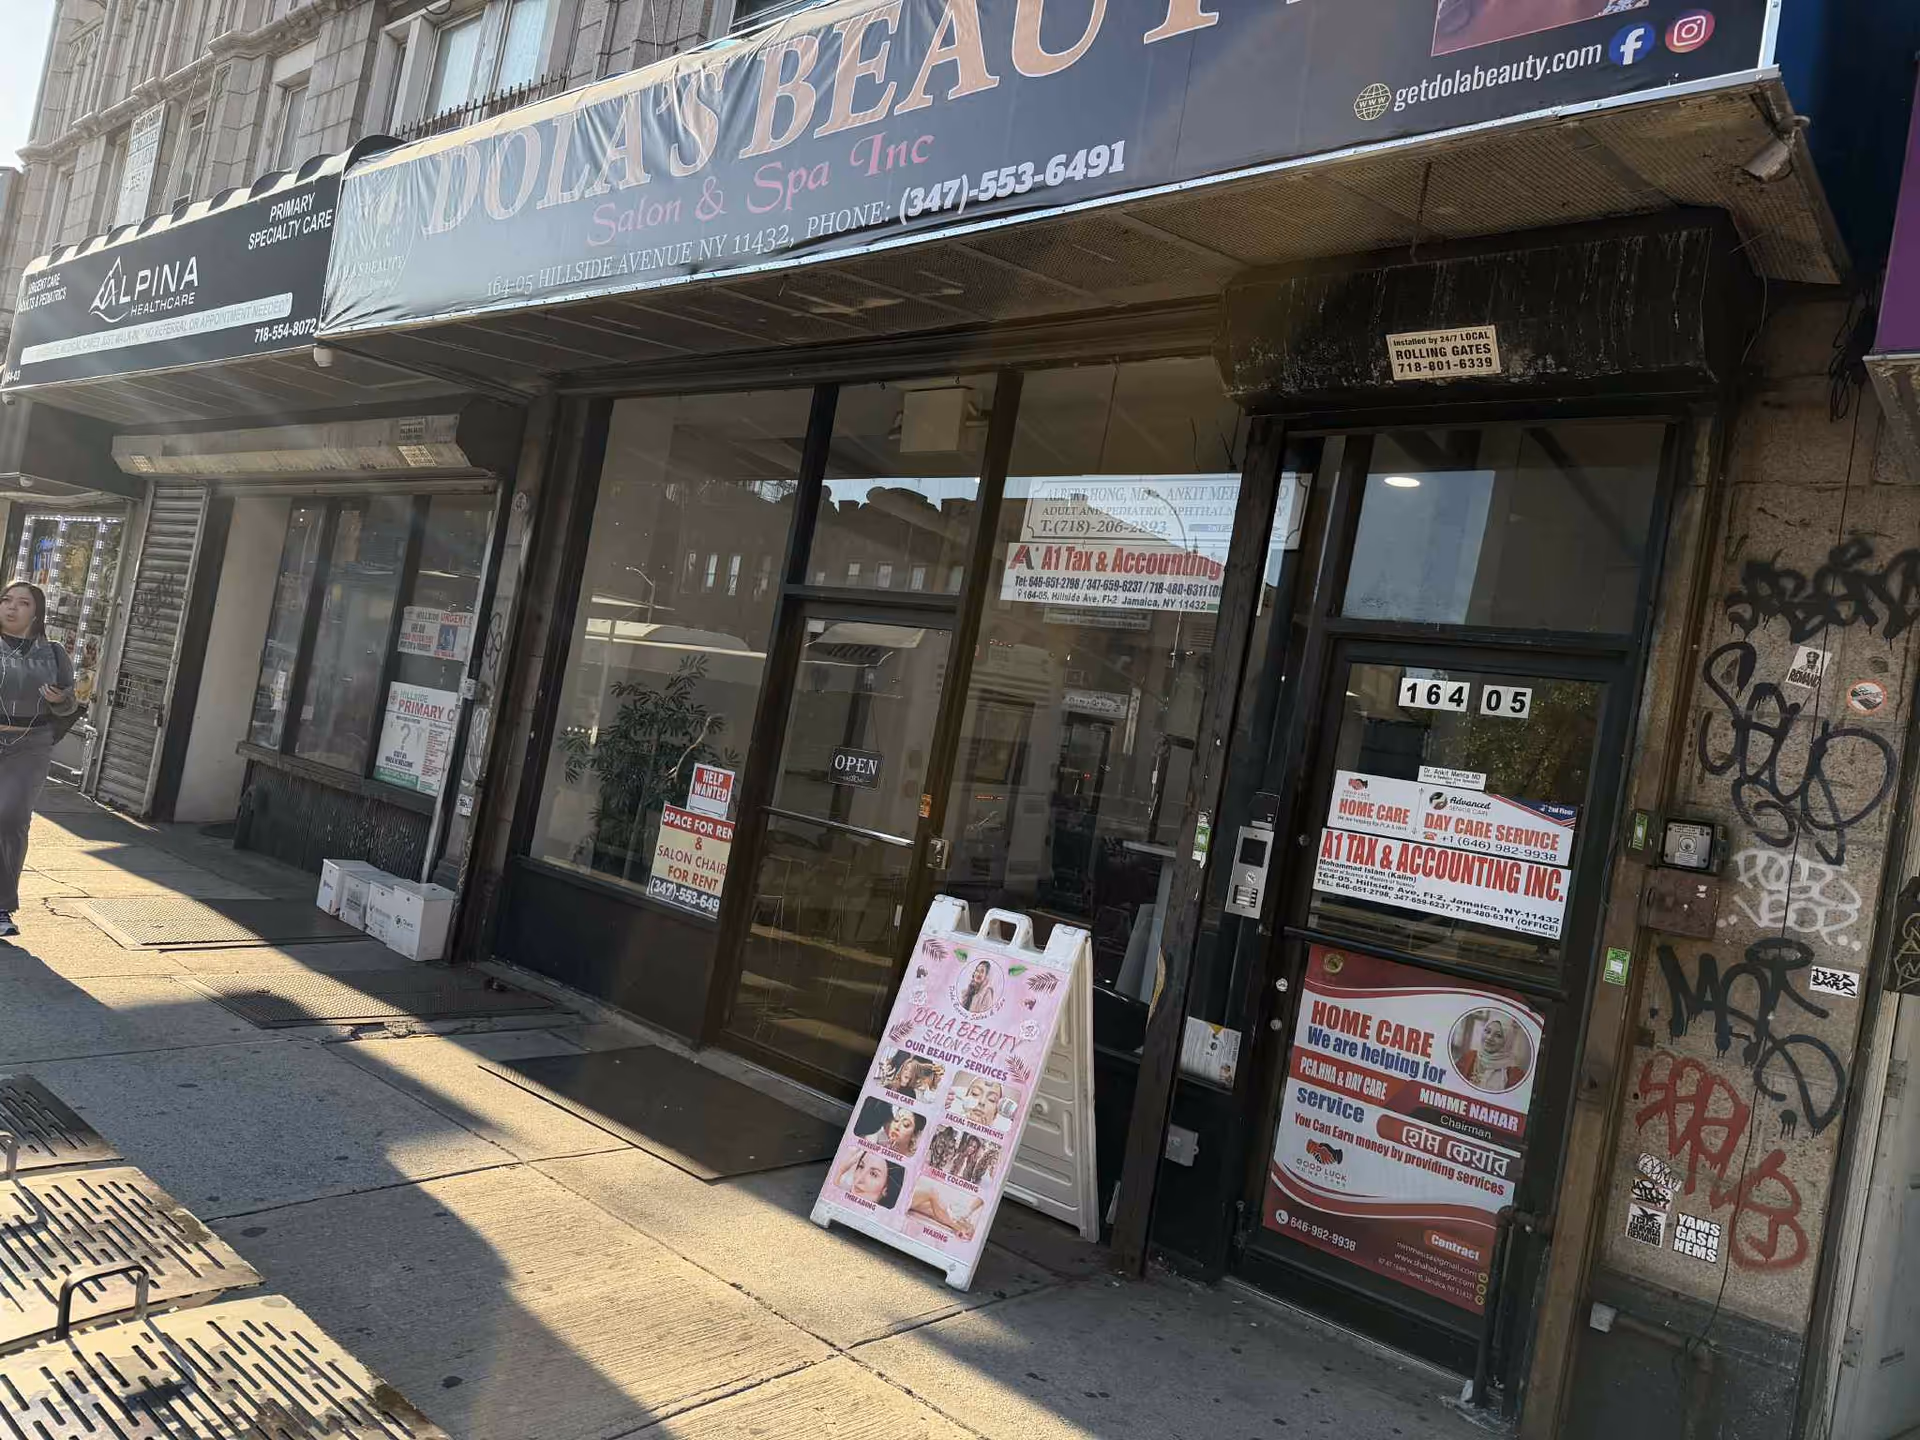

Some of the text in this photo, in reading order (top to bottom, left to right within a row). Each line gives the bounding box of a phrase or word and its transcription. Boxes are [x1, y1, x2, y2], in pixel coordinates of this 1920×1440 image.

[1393, 44, 1602, 111] getdolabeauty.com
[422, 0, 1305, 236] DOLA'S BEAU
[586, 133, 935, 247] Salon & Spa Inc
[270, 192, 315, 220] PRIMARY
[487, 140, 1126, 297] 164-05 HILLSIDE AVENUE NY 11432, PHONE: (347)-553-6491
[249, 209, 333, 250] SPECIALTY CARE
[92, 256, 200, 308] ALPINA
[130, 292, 196, 316] HEALTHCARE
[254, 318, 316, 343] 718-554-8072
[1393, 331, 1490, 346] Installed by 24/7 LOCAL
[1396, 343, 1491, 360] ROLLING GATES
[1398, 357, 1493, 373] 718-801-6339
[1042, 507, 1075, 516] ADULT
[1041, 546, 1062, 570] A1
[1065, 546, 1094, 571] Tax
[1095, 551, 1108, 572] &
[1111, 547, 1223, 581] Accounting
[1052, 592, 1081, 602] Hillside
[1162, 598, 1176, 608] NY
[1180, 599, 1207, 610] 11432
[398, 699, 444, 720] PRIMARY
[1406, 682, 1528, 713] 164 05
[703, 769, 723, 785] HELP
[834, 754, 878, 775] OPEN
[694, 782, 727, 801] WANTED
[1449, 796, 1491, 810] Advanced
[664, 810, 734, 839] SPACE FOR REN
[1338, 798, 1411, 825] HOME CARE
[694, 837, 703, 850] &
[1424, 812, 1560, 851] DAY CARE SERVICE
[657, 845, 692, 865] SALON
[1457, 837, 1491, 850] (646)
[1495, 844, 1557, 862] 982-9938
[667, 865, 719, 890] FOR RENT
[1319, 859, 1362, 872] Mohammad
[1364, 865, 1386, 876] Islam
[1321, 830, 1564, 903] A1 TAX & ACCOUNTING INC.
[649, 877, 720, 913] (347)-553-649
[1318, 872, 1353, 884] 164-05,
[1356, 877, 1394, 891] Hillside
[1449, 897, 1500, 913] Jamaica,
[1504, 907, 1560, 924] NY-11432
[1517, 919, 1559, 933] (OFFICE)
[913, 1006, 1020, 1053] DOLA BEAUTY
[1310, 1000, 1435, 1059] HOME CARE
[922, 1029, 962, 1051] SALON
[971, 1045, 997, 1063] SPA
[1307, 1026, 1447, 1084] We are helping for
[905, 1039, 1009, 1081] OUR BEAUTY SERVICES
[1337, 1071, 1344, 1085] &
[1345, 1071, 1364, 1092] DAY
[1363, 1076, 1387, 1100] CARE
[1297, 1087, 1365, 1123] service
[1419, 1087, 1519, 1132] NIMME NAHAR
[945, 1113, 1005, 1140] FACIAL TREATMENTS
[1402, 1125, 1443, 1154] হোম
[1440, 1115, 1492, 1139] Chairman
[881, 1147, 904, 1162] SERVICE
[1295, 1112, 1505, 1196] You Can Earn money by providing services
[931, 1168, 979, 1193] HAIR COLORING
[1296, 1158, 1322, 1172] GOOD
[1324, 1169, 1347, 1182] LUCK
[922, 1227, 949, 1243] WAXING
[1290, 1216, 1357, 1252] 646-982-9938
[1675, 1225, 1719, 1250] GASH
[1679, 1213, 1721, 1237] YAMS
[1431, 1234, 1480, 1261] Contract
[1673, 1238, 1717, 1263] HEMS
